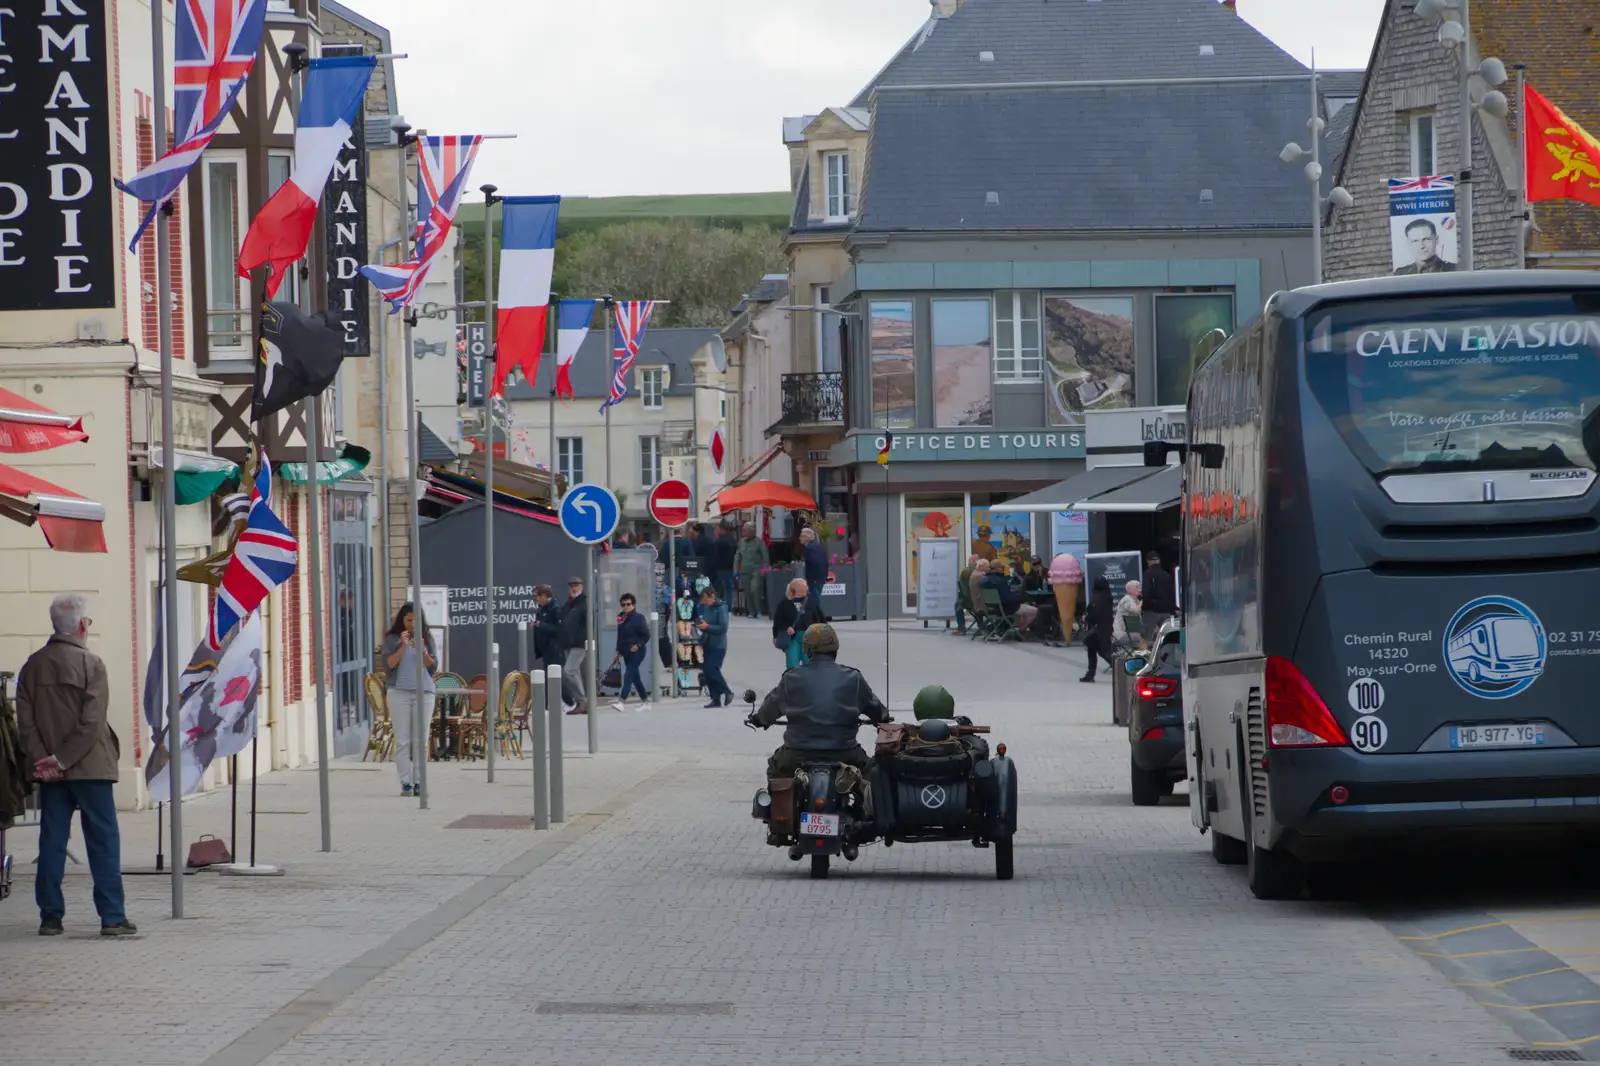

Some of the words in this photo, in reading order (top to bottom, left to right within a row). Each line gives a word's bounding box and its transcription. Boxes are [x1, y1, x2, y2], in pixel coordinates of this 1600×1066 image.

[1395, 202, 1417, 210] WWII
[1418, 200, 1450, 209] HEROES
[1356, 327, 1448, 357] CAEN
[1460, 320, 1600, 352] EVASION
[471, 327, 486, 398] HOTEL
[1494, 355, 1533, 363] TOURISME
[1390, 411, 1424, 427] Votre
[1480, 409, 1517, 423] notre
[874, 436, 956, 450] OFFICE
[964, 435, 991, 449] DE
[998, 434, 1081, 449] TOURIS
[508, 585, 536, 596] MAR
[1344, 632, 1394, 645] Chemin
[1398, 630, 1432, 642] Rural
[1549, 632, 1567, 643] 02
[1570, 631, 1584, 642] 31
[1369, 648, 1409, 659] 14320
[1347, 663, 1438, 677] May-sur-Orne
[1356, 682, 1380, 710] 100
[1356, 720, 1382, 748] 90
[1460, 727, 1534, 743] HD-977-YG
[811, 815, 823, 825] RE
